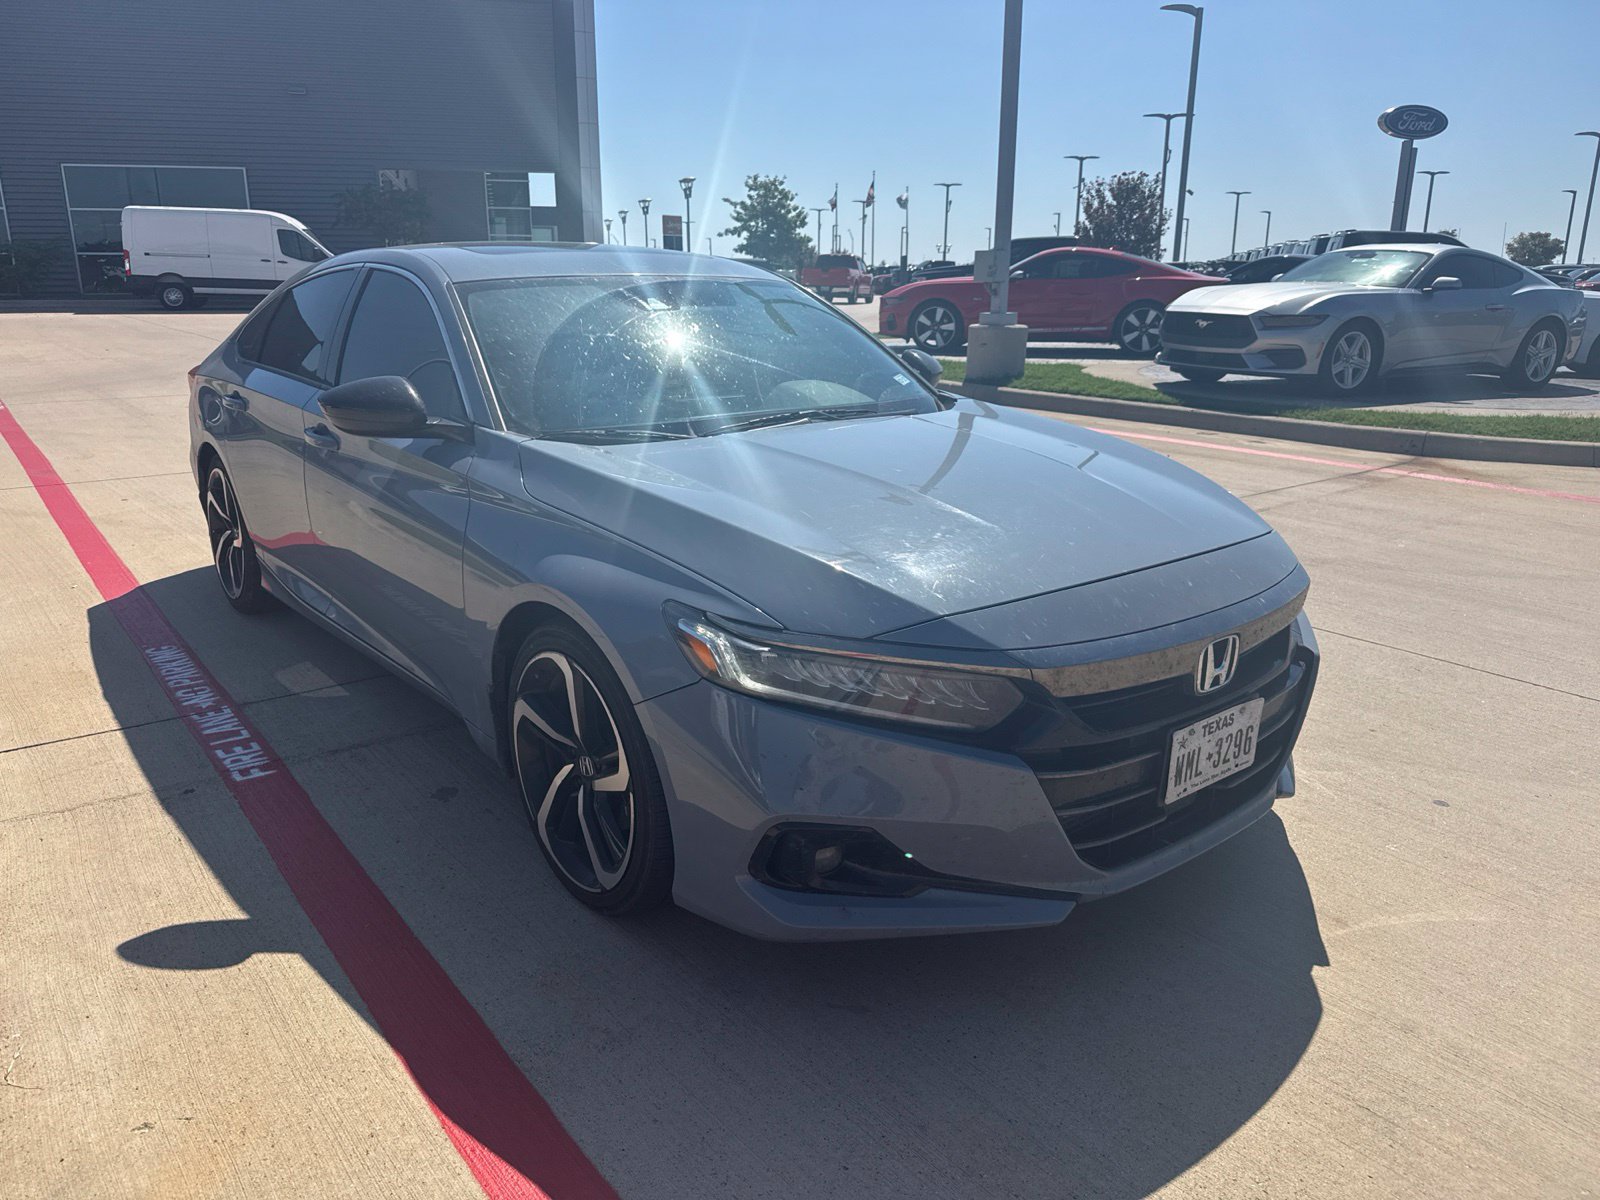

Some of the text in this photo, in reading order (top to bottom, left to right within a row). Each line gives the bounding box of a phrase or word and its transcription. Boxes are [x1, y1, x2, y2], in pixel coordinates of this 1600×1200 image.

[1398, 111, 1436, 131] Ford
[145, 645, 204, 688] PARKING
[175, 686, 220, 706] NO
[1202, 712, 1235, 737] TEXAS
[215, 741, 277, 782] FIRE
[1212, 725, 1254, 769] 3296
